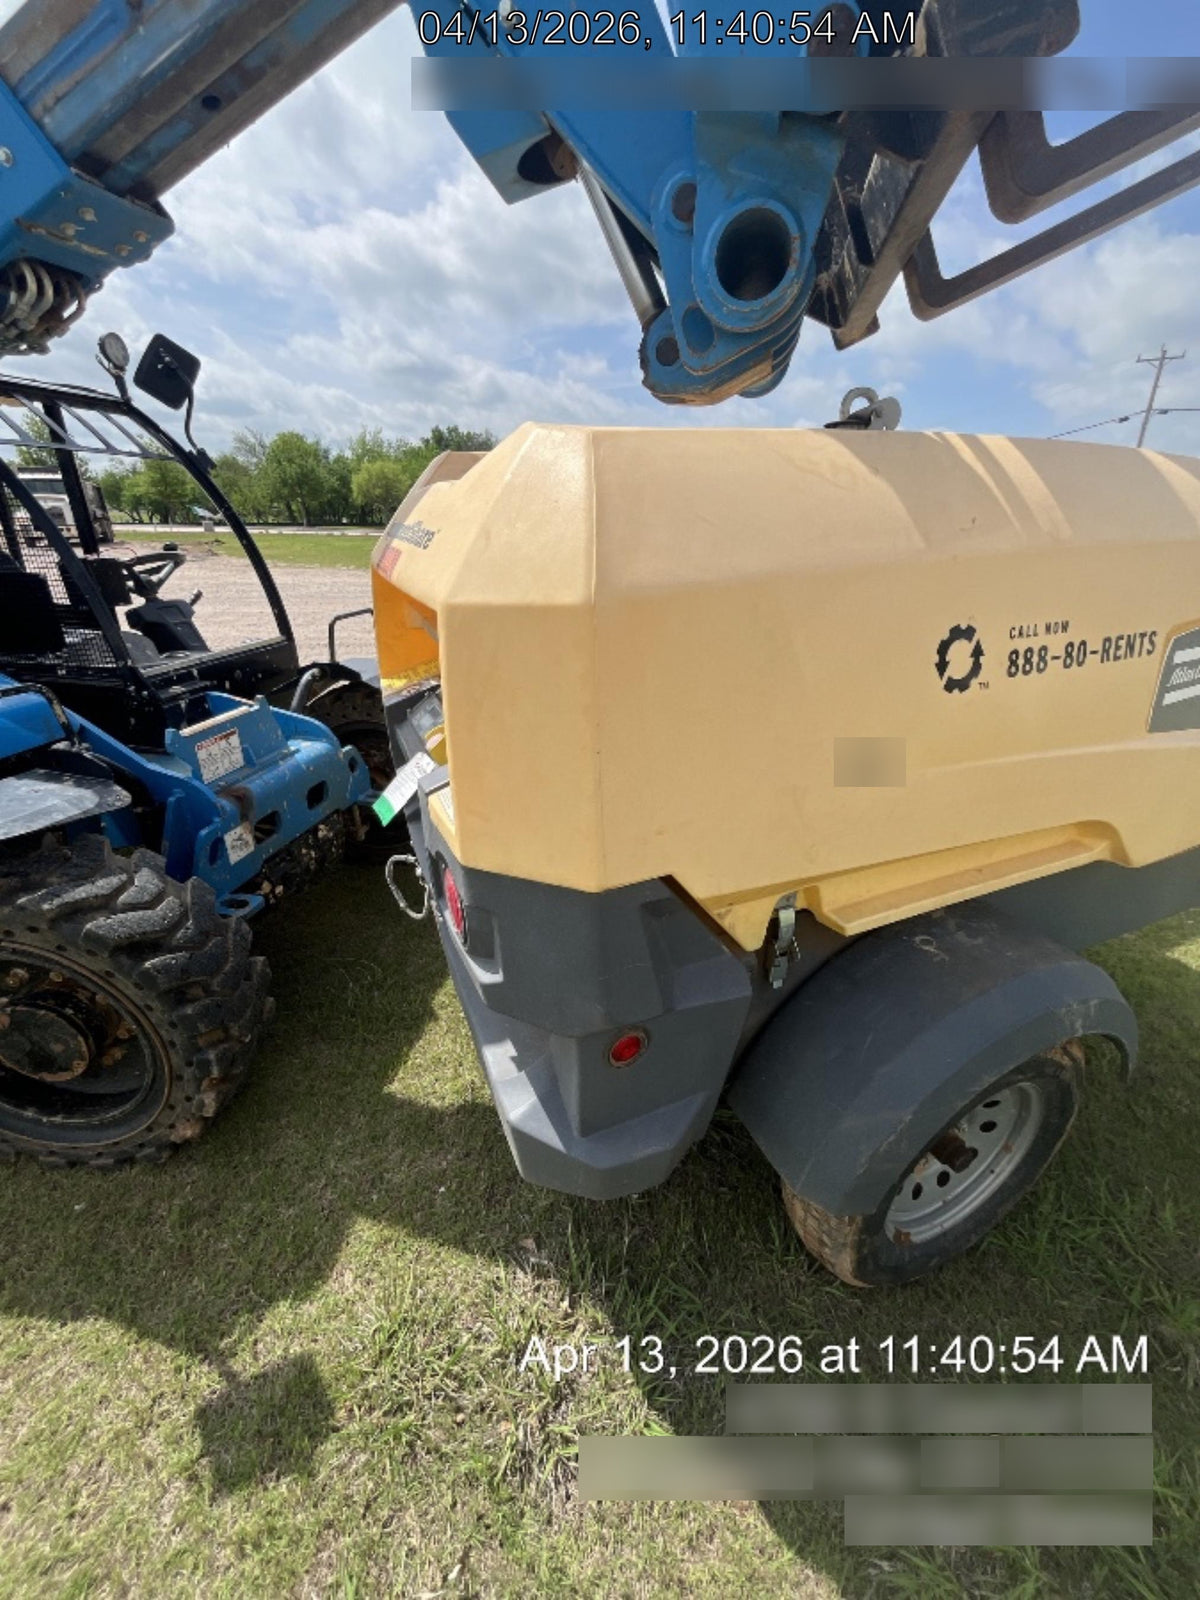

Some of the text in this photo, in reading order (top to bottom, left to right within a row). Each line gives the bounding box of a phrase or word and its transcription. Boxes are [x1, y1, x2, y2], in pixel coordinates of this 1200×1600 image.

[1009, 620, 1070, 640] CALL NOW
[1006, 630, 1158, 678] 888-80-RENTS
